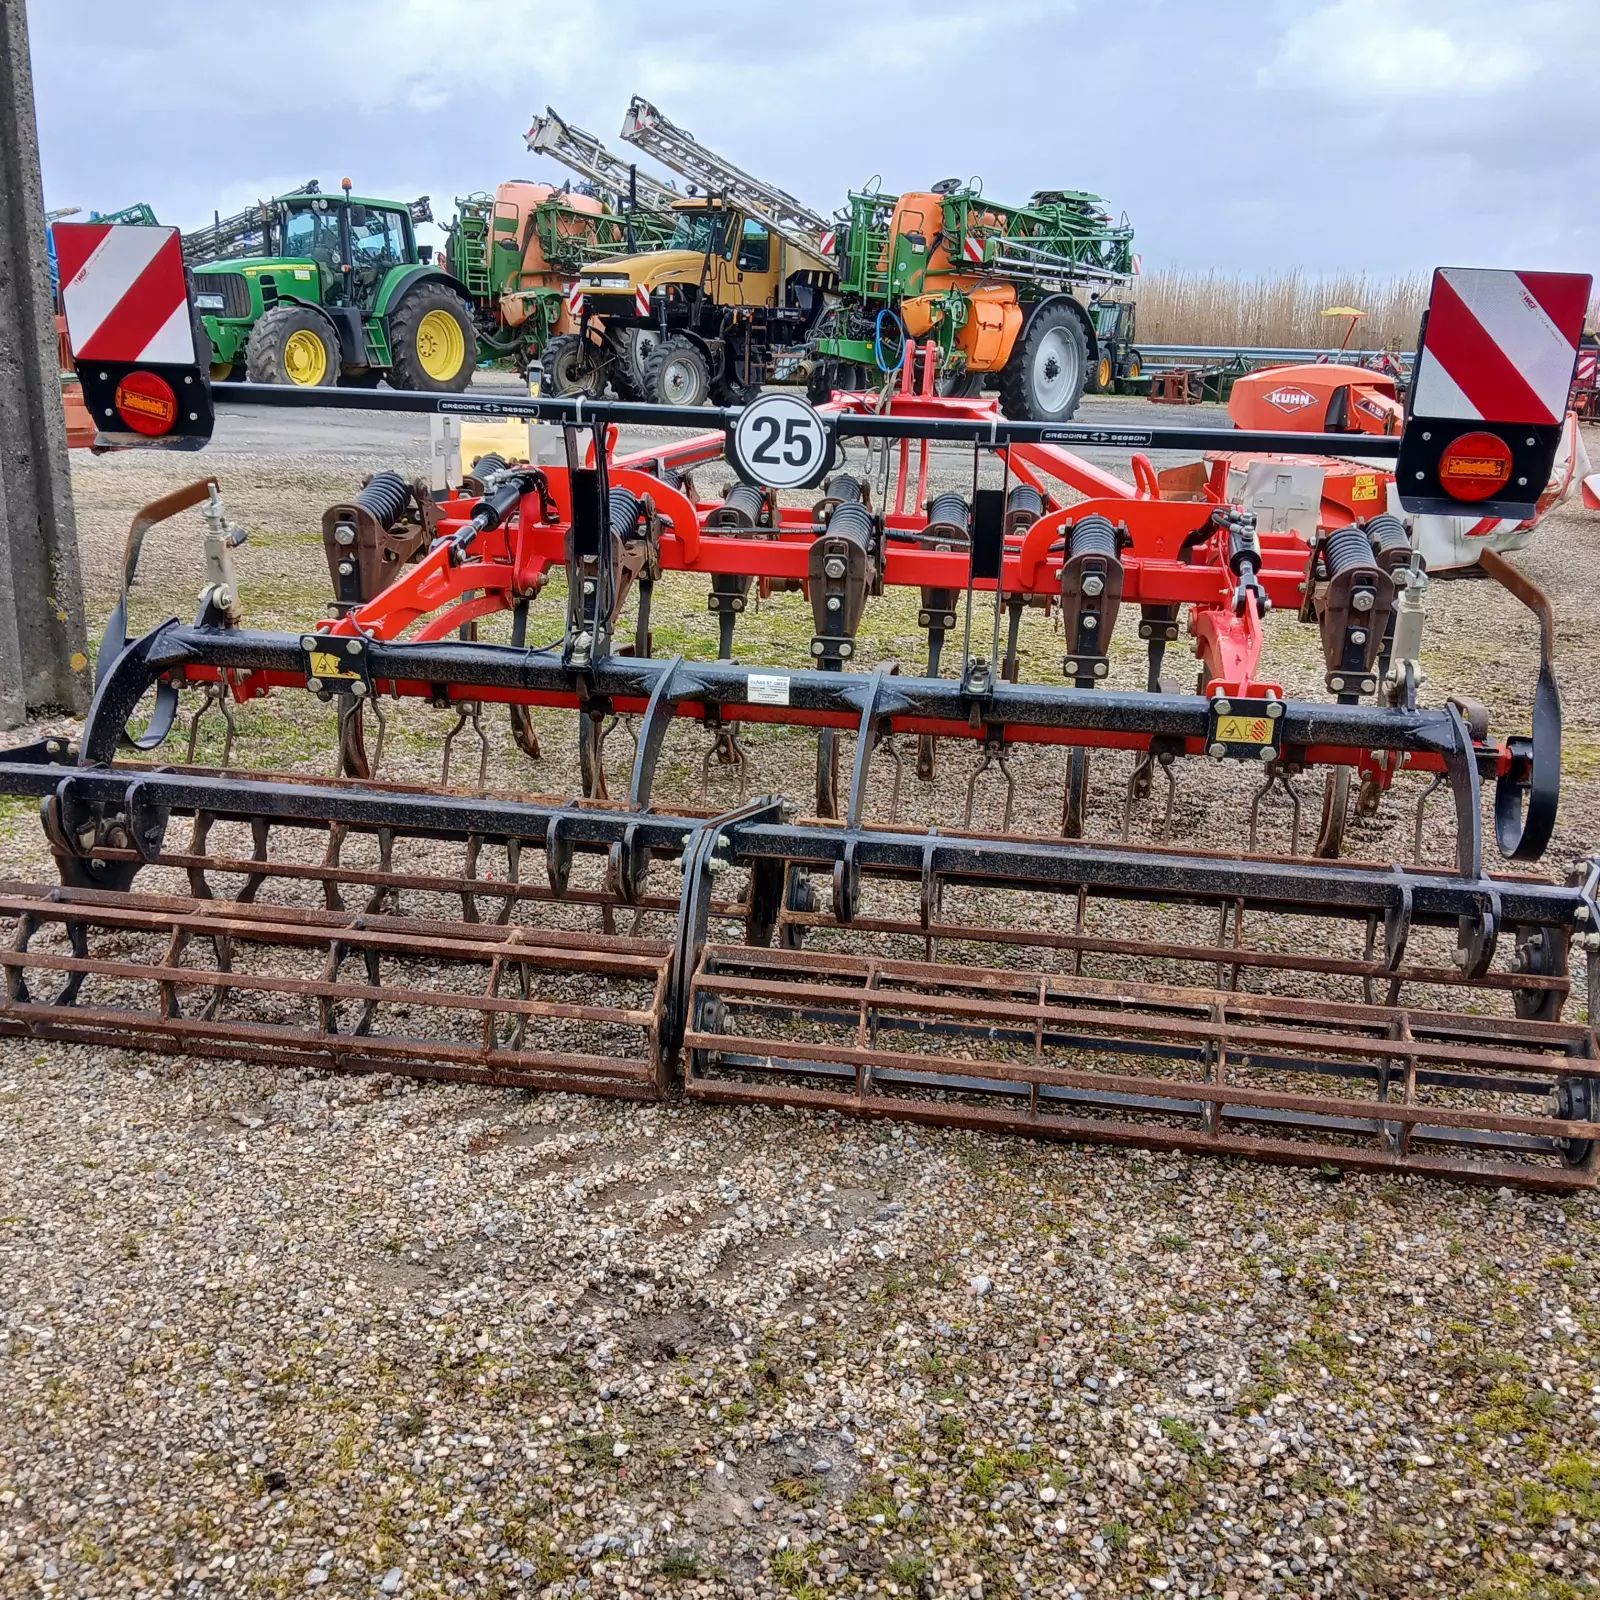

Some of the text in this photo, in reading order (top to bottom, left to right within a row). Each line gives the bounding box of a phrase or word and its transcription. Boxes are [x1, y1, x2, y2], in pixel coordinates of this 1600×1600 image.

[1271, 393, 1310, 406] KUHN
[502, 406, 535, 414] BESSON
[752, 416, 812, 467] 25
[1111, 434, 1147, 442] BESSON
